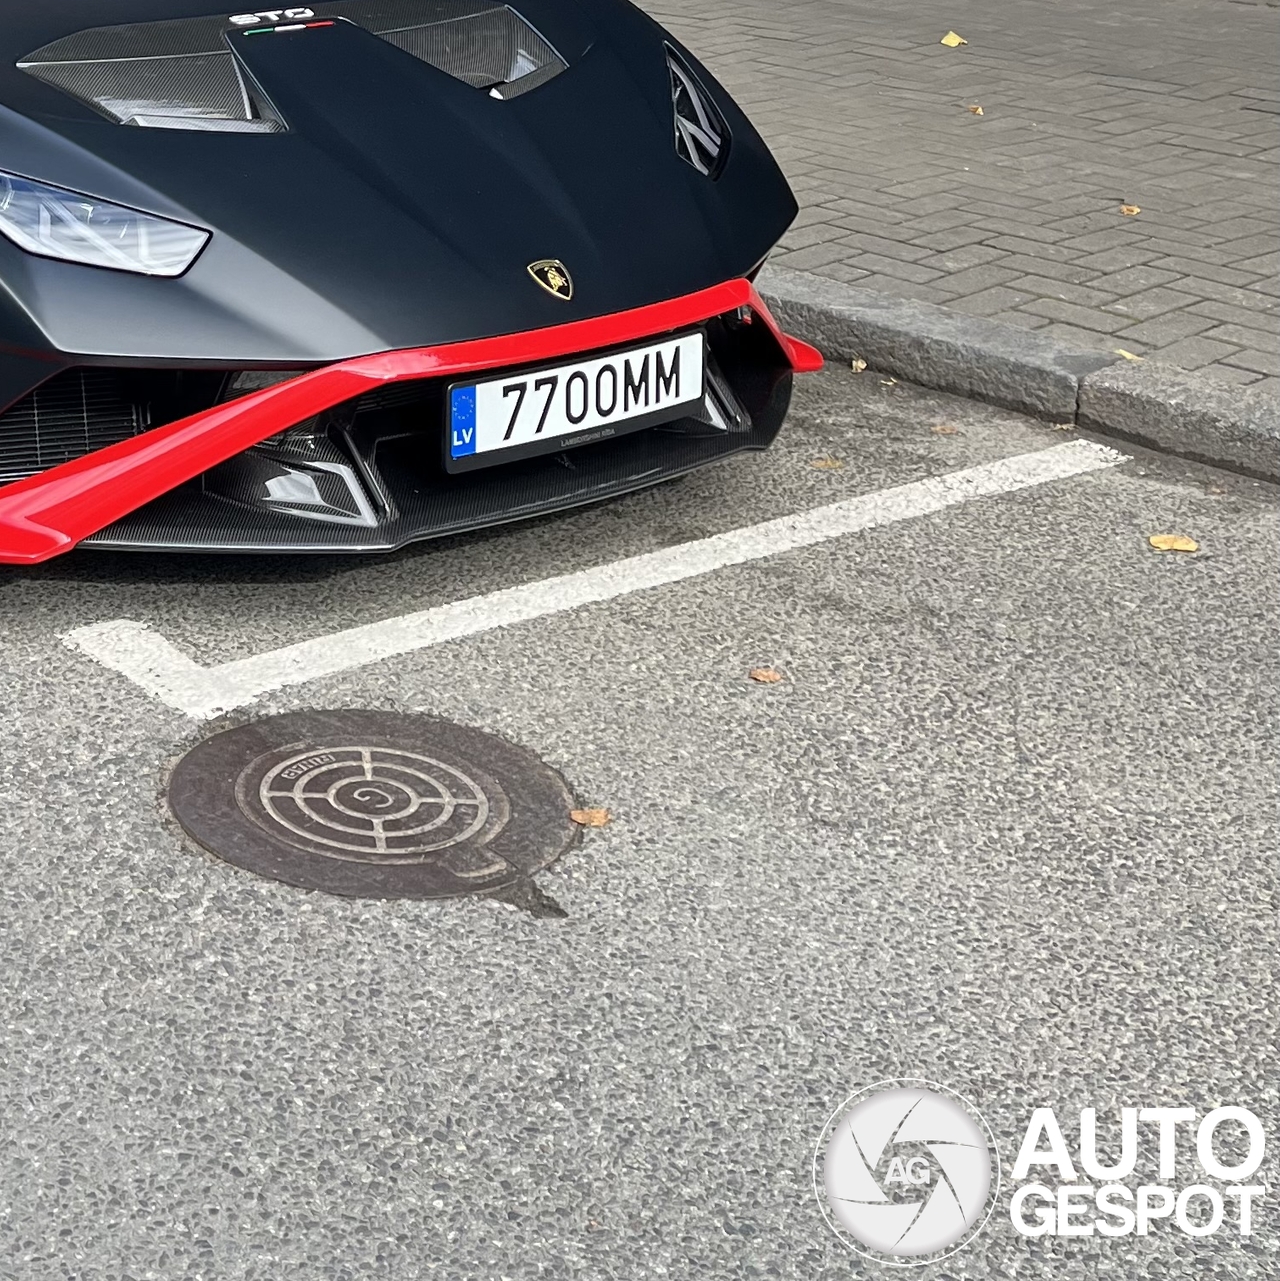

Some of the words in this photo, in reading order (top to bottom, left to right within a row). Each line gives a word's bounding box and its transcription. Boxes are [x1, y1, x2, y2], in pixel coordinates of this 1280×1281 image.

[228, 7, 315, 25] STO
[503, 345, 681, 441] 7700MM
[452, 427, 473, 447] LV
